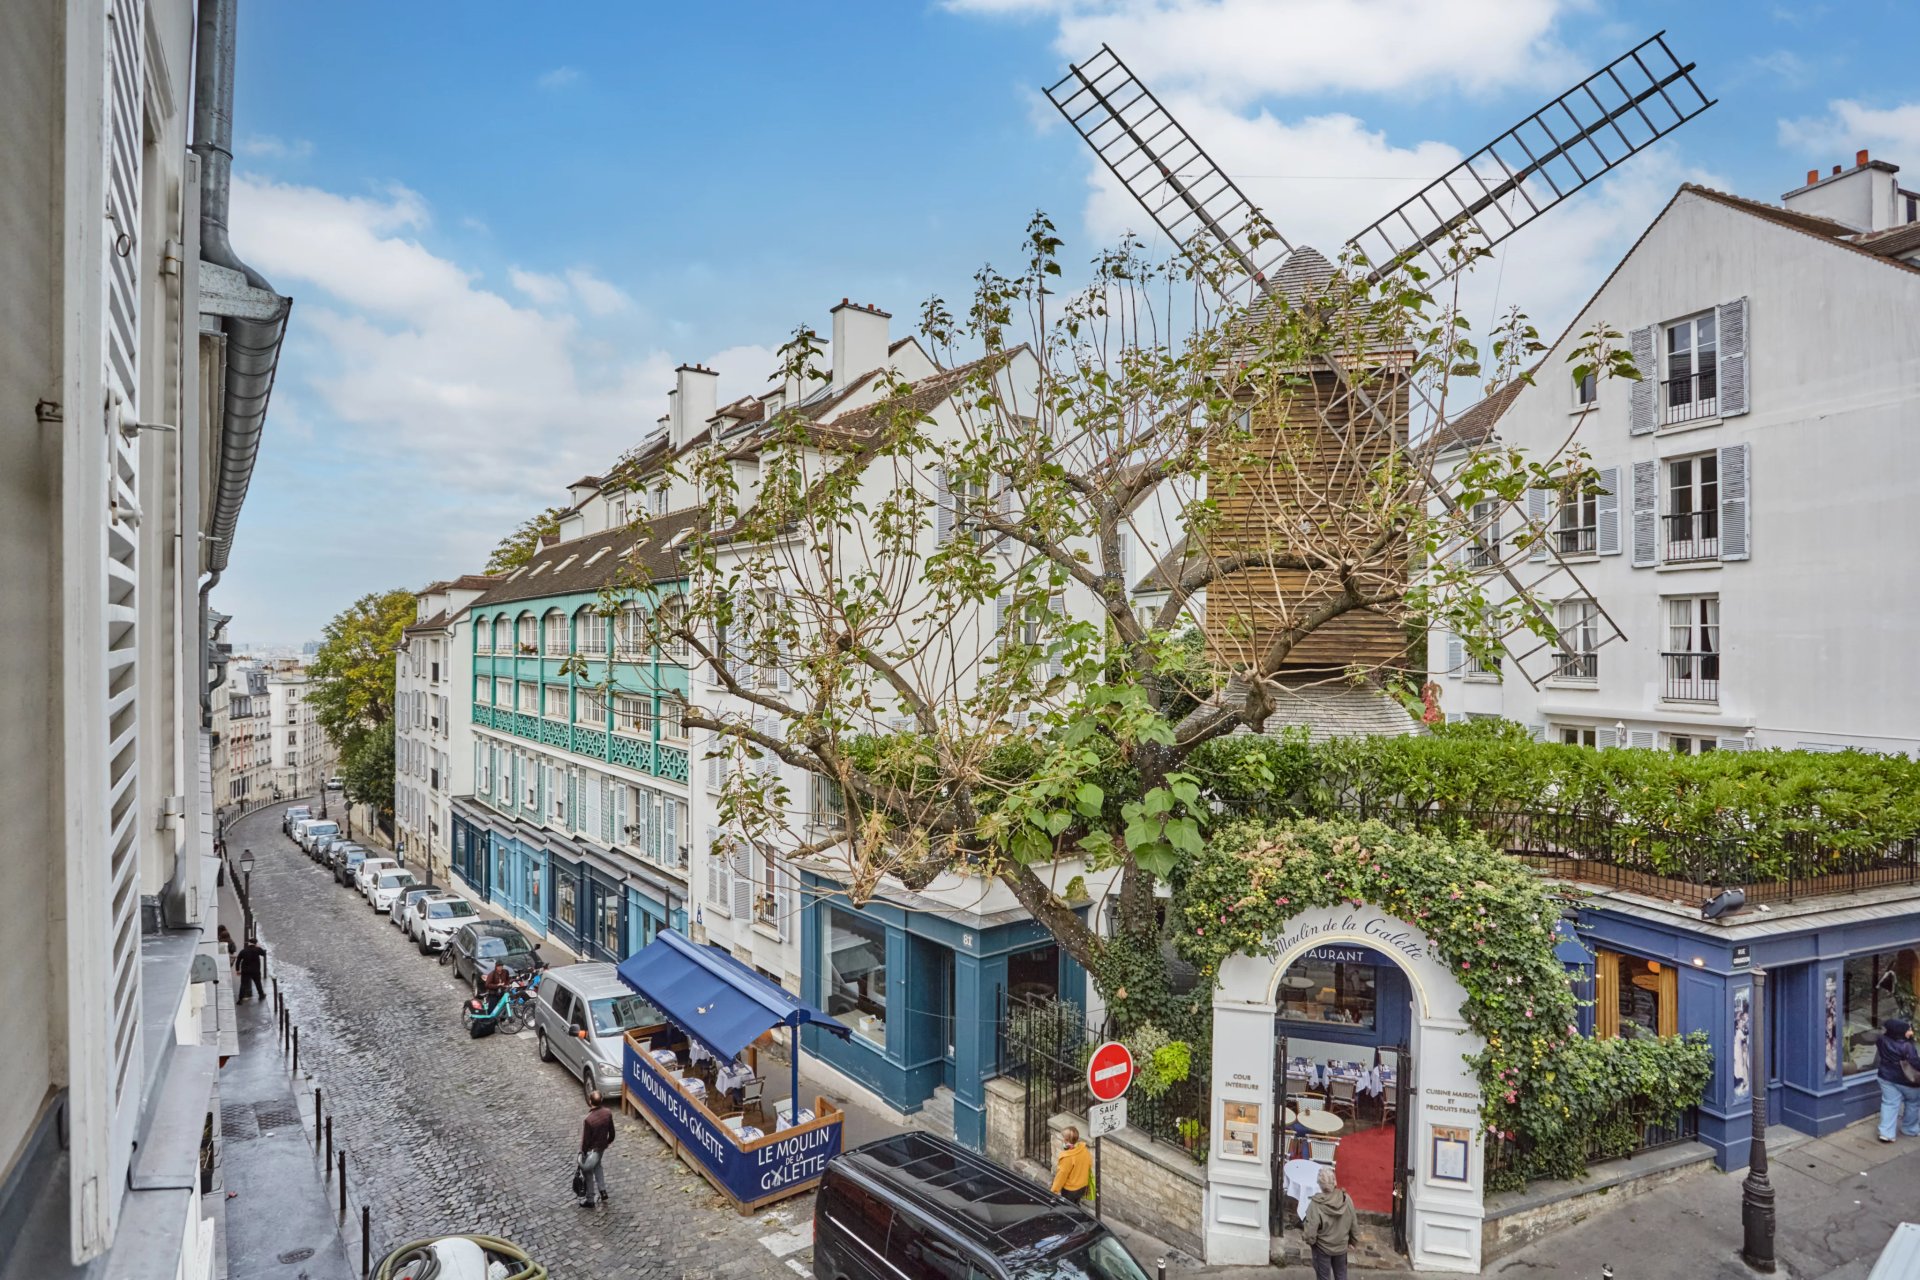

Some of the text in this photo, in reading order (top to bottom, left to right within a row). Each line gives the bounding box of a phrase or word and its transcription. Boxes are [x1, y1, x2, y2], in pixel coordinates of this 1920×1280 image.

[1272, 922, 1320, 956] Moulin
[1322, 917, 1338, 932] de
[1341, 914, 1357, 931] la
[1364, 918, 1423, 962] Galette
[633, 1060, 641, 1080] LE
[641, 1068, 667, 1106] MOULIN
[668, 1094, 678, 1118] DE
[679, 1104, 688, 1127] LA
[1425, 1088, 1479, 1099] CUISINE MAISON
[1099, 1102, 1119, 1115] SAUF
[1425, 1104, 1458, 1113] PRODUITS
[758, 1126, 829, 1166] LE MOULIN
[785, 1152, 804, 1166] DE LA
